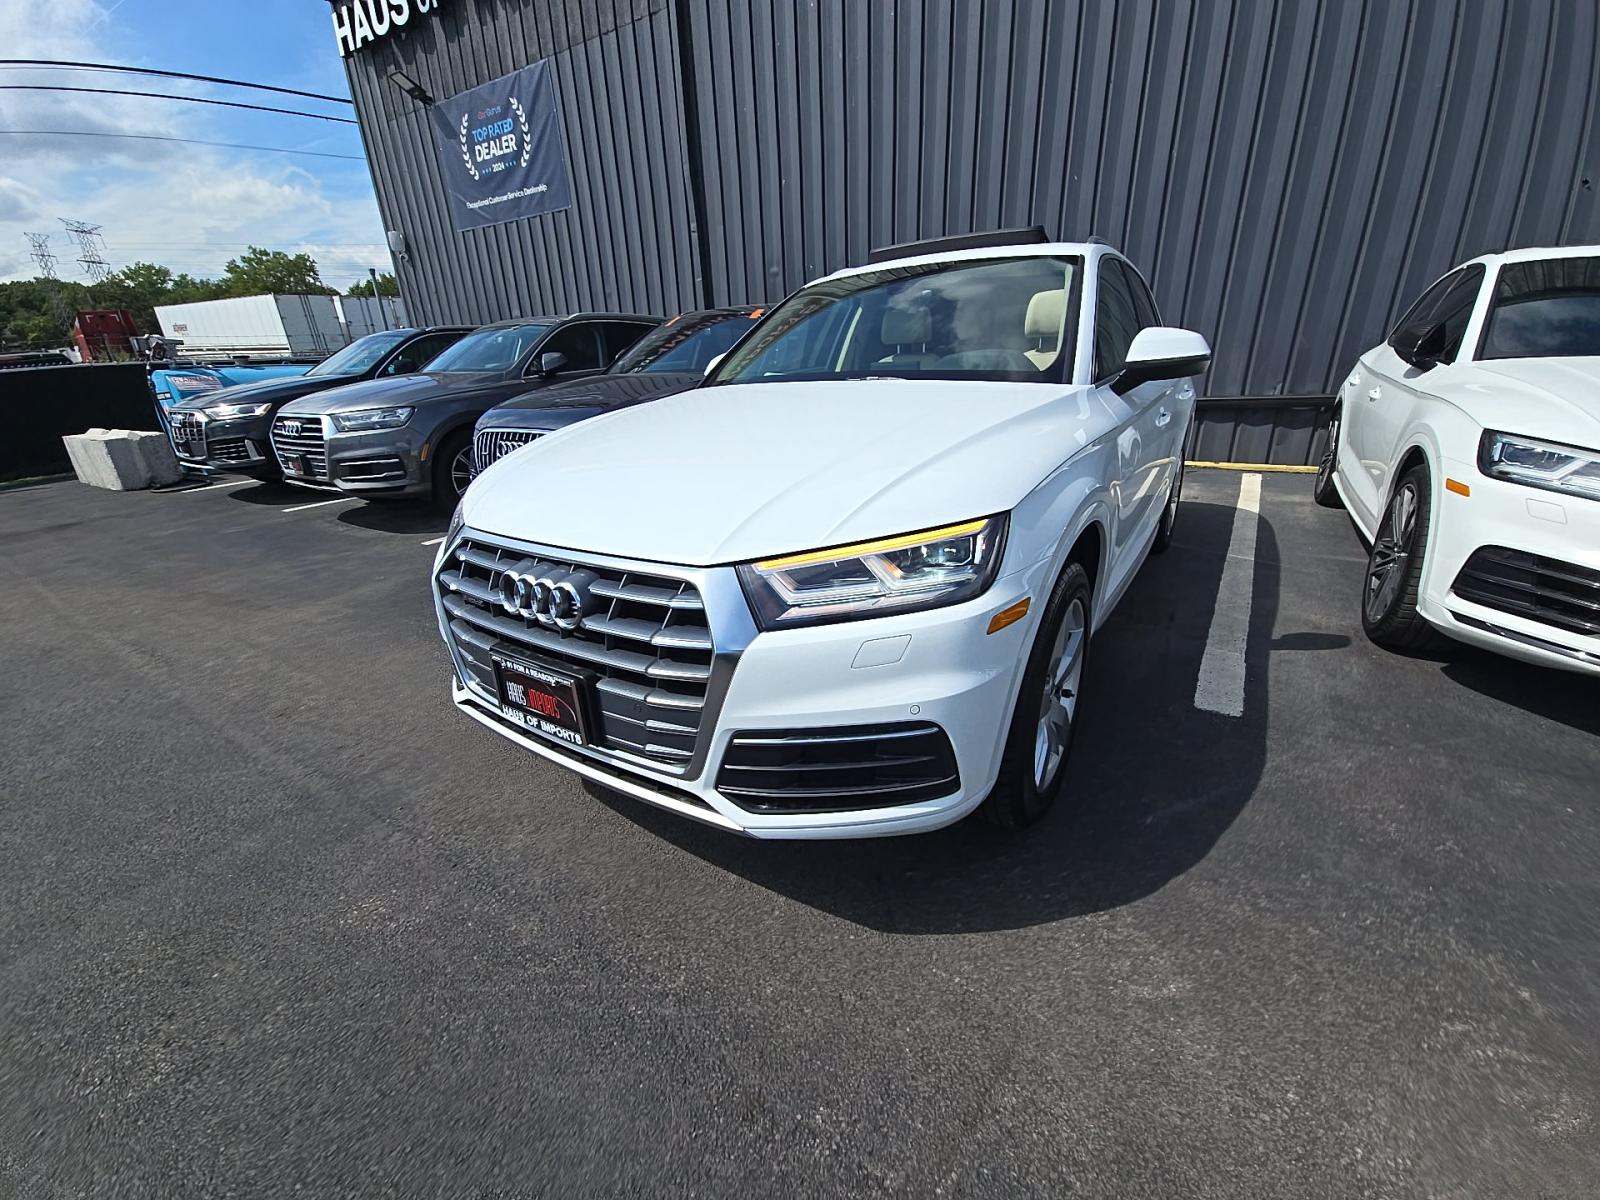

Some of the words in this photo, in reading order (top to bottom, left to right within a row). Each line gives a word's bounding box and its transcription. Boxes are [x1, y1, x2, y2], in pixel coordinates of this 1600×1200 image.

[332, 0, 410, 57] HAUS
[472, 128, 488, 143] TOP
[488, 118, 514, 138] RATED
[475, 134, 518, 163] DEALER
[492, 163, 505, 173] 2024
[502, 704, 525, 725] HAUS
[526, 714, 538, 728] OF
[540, 719, 582, 745] IMPORTS
